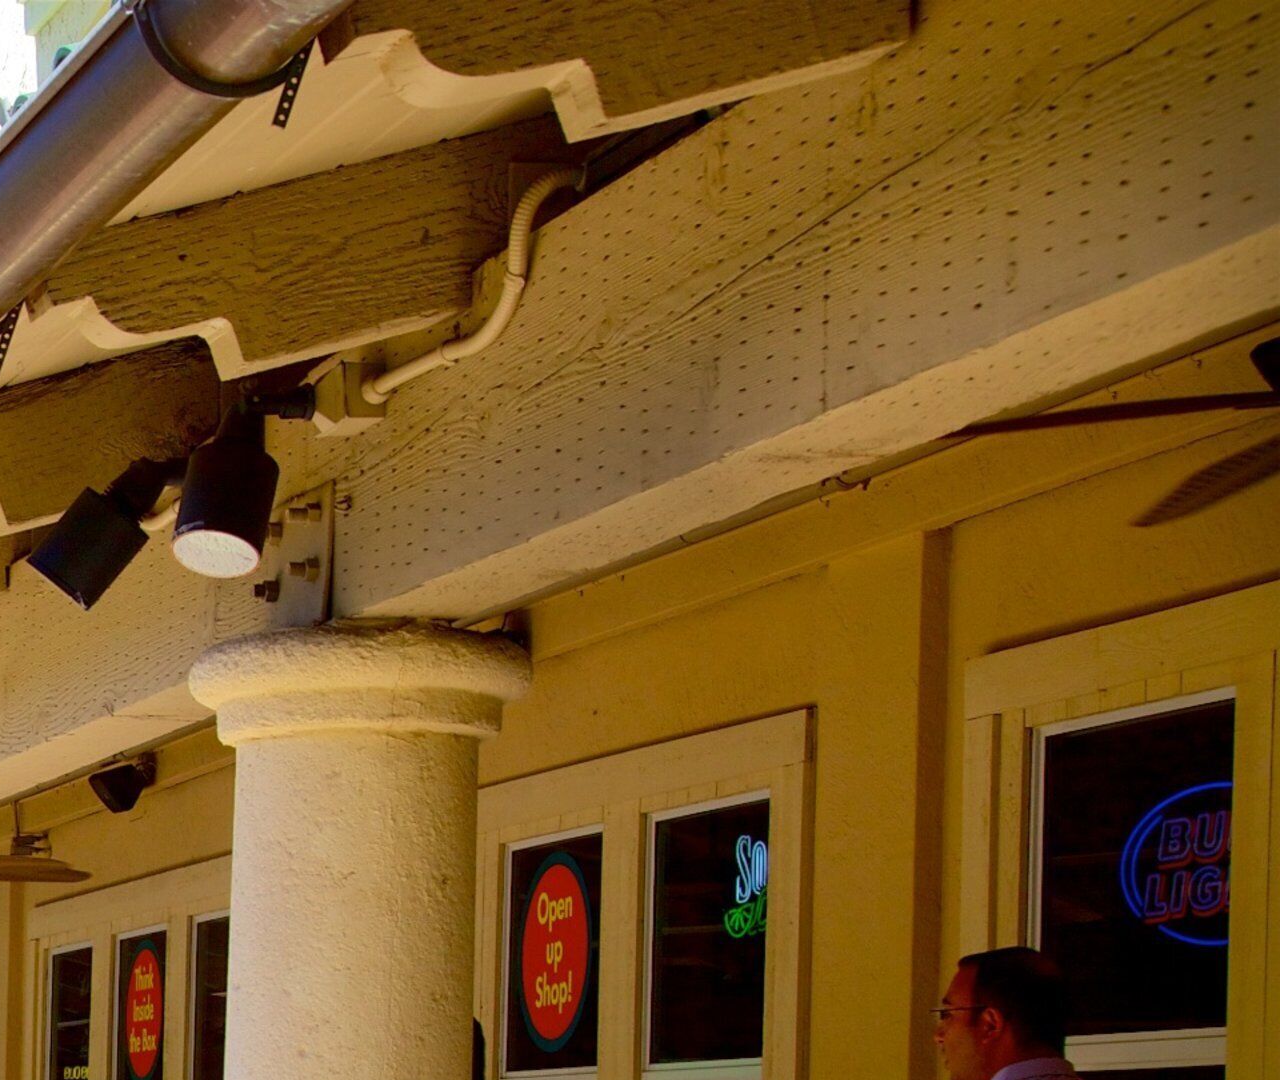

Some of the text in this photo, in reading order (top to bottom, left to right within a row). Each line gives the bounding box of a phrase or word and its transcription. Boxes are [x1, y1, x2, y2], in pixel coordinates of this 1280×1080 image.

[1157, 811, 1231, 868] BU
[537, 892, 573, 932] Open
[1143, 866, 1230, 923] LIG
[546, 940, 563, 973] up
[535, 970, 572, 1014] Shop!
